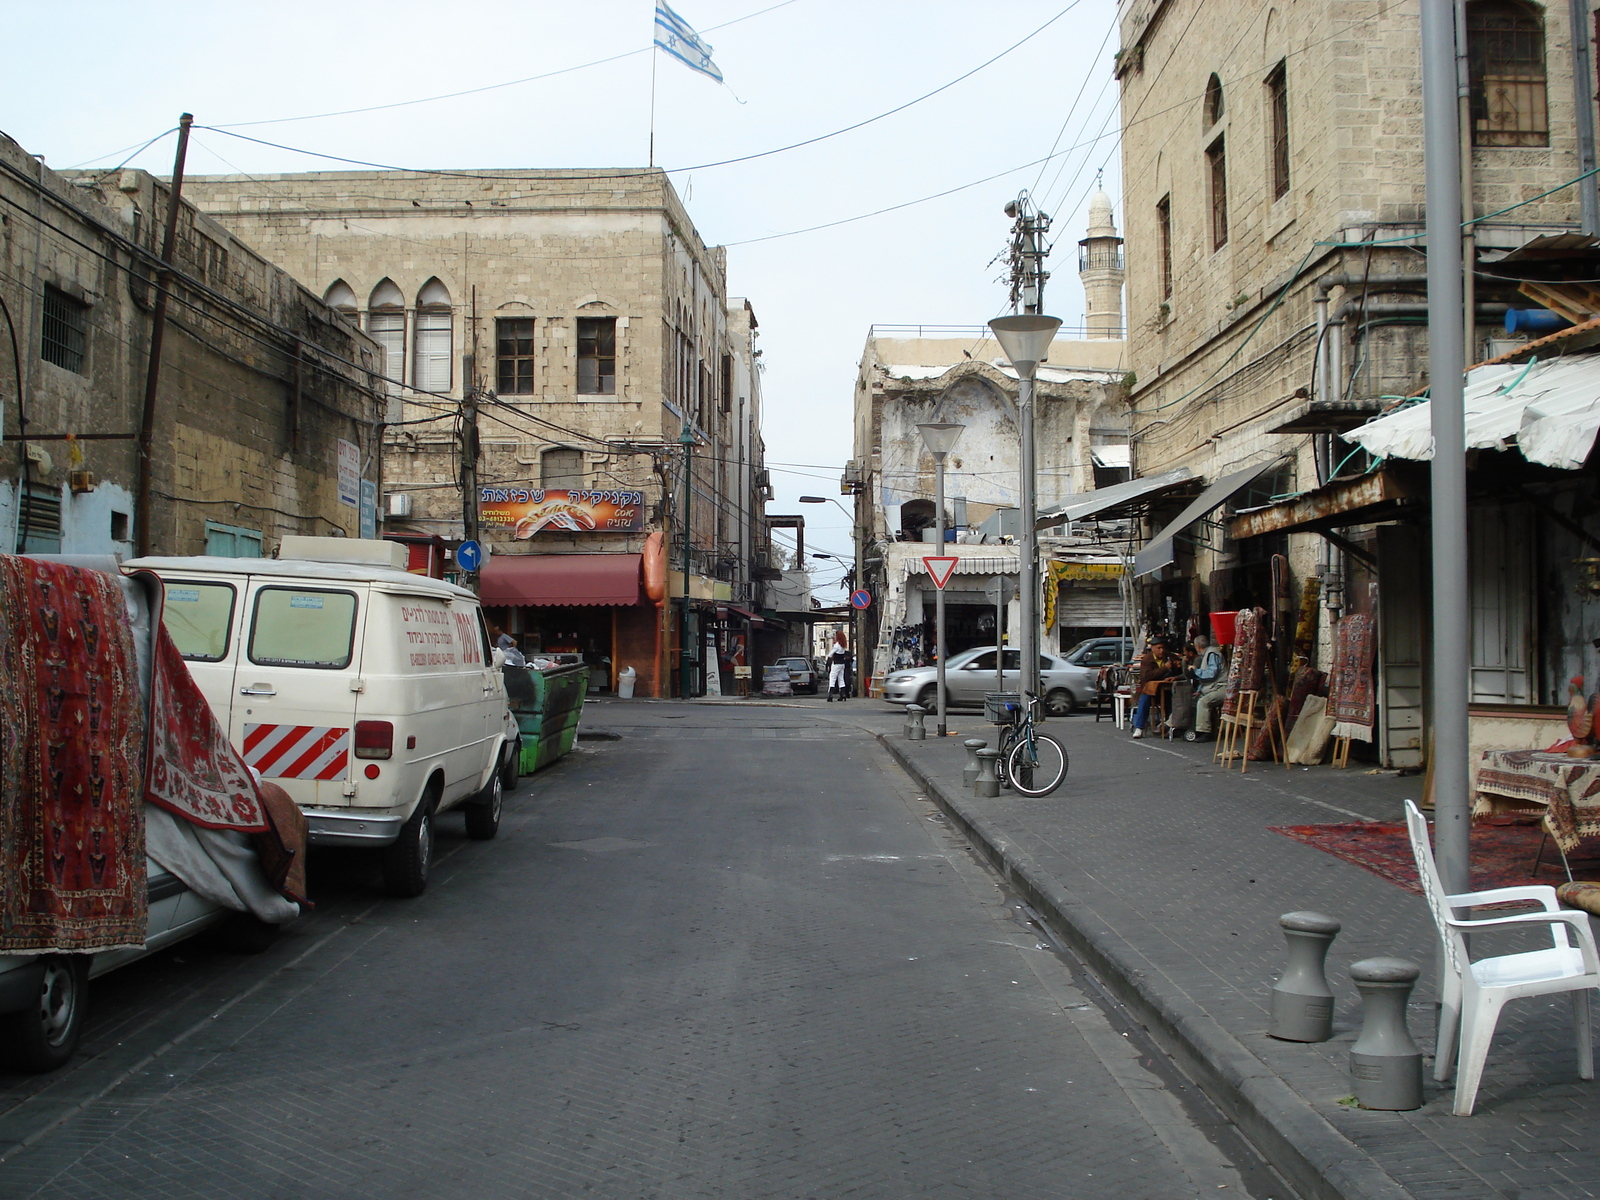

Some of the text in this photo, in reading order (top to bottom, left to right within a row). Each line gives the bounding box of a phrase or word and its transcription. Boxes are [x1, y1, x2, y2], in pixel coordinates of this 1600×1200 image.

[482, 488, 641, 508] נקניקיה שכזאת
[606, 518, 632, 528] נקניק
